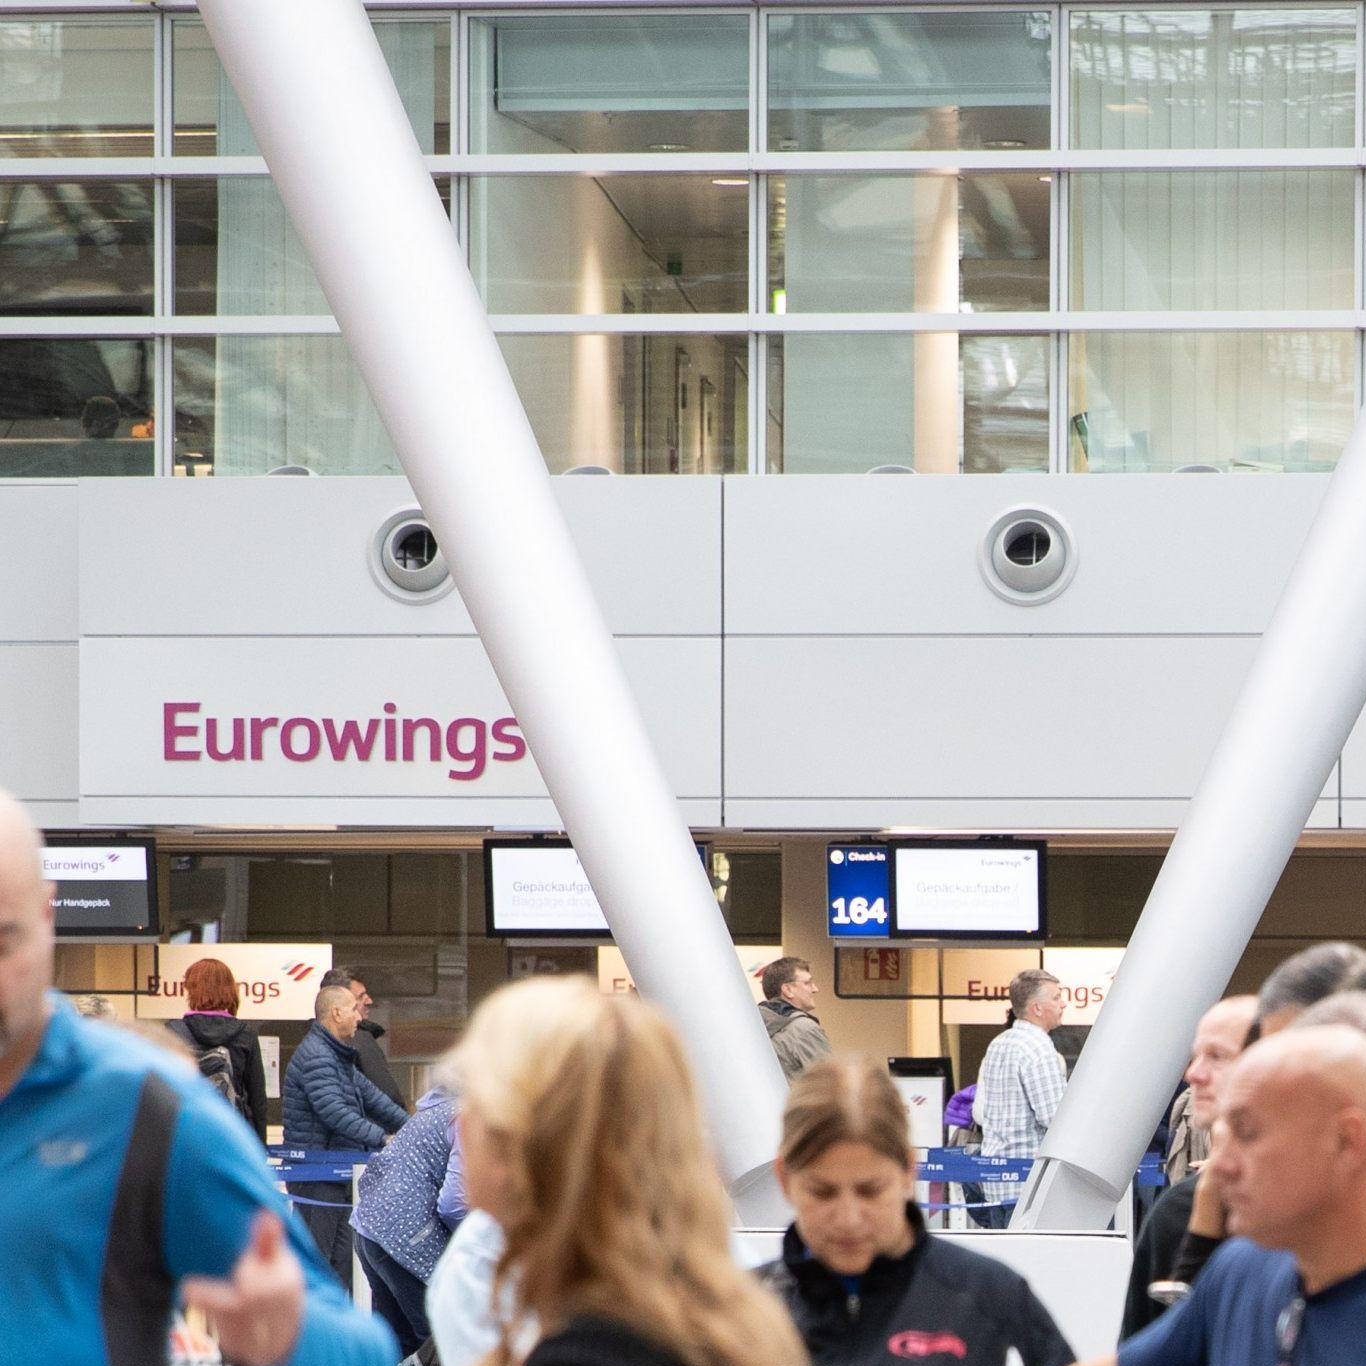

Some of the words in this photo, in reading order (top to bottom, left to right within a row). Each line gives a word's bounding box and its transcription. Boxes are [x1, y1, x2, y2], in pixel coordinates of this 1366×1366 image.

[163, 702, 527, 781] Eurowings
[43, 860, 105, 873] Eurowings
[512, 880, 593, 893] Gepäckaufga
[832, 897, 887, 925] 164
[148, 975, 280, 1004] Eurngs
[968, 981, 1103, 1009] Eurngs
[1002, 1172, 1019, 1181] DUS
